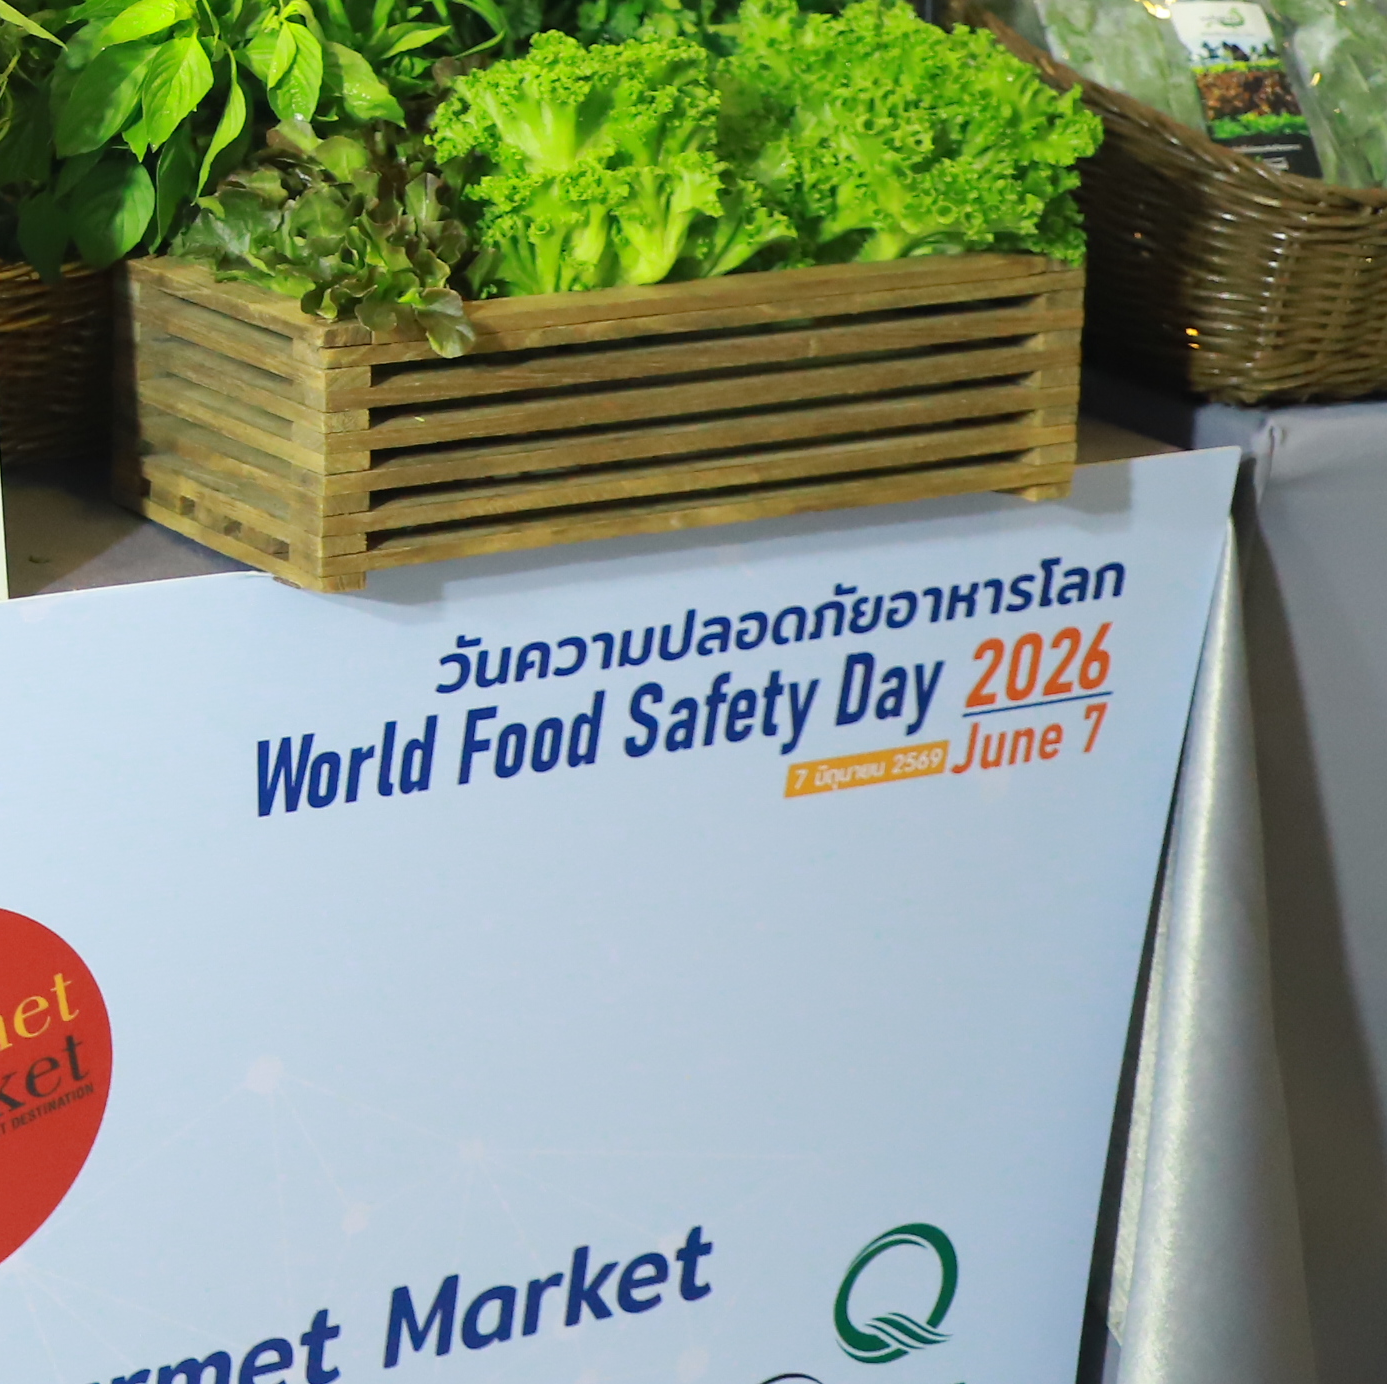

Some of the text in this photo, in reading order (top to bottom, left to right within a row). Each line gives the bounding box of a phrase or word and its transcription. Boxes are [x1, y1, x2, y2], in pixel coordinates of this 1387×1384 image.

[435, 557, 1126, 694] วันความปลอดภัยอาหารโลก
[257, 621, 1113, 817] World Food Safety Day 2026
[794, 747, 944, 790] 7 มิถุนายน 2569
[950, 701, 1109, 775] June 7
[12, 1082, 95, 1129] DESTINATION
[382, 1225, 713, 1368] Market
